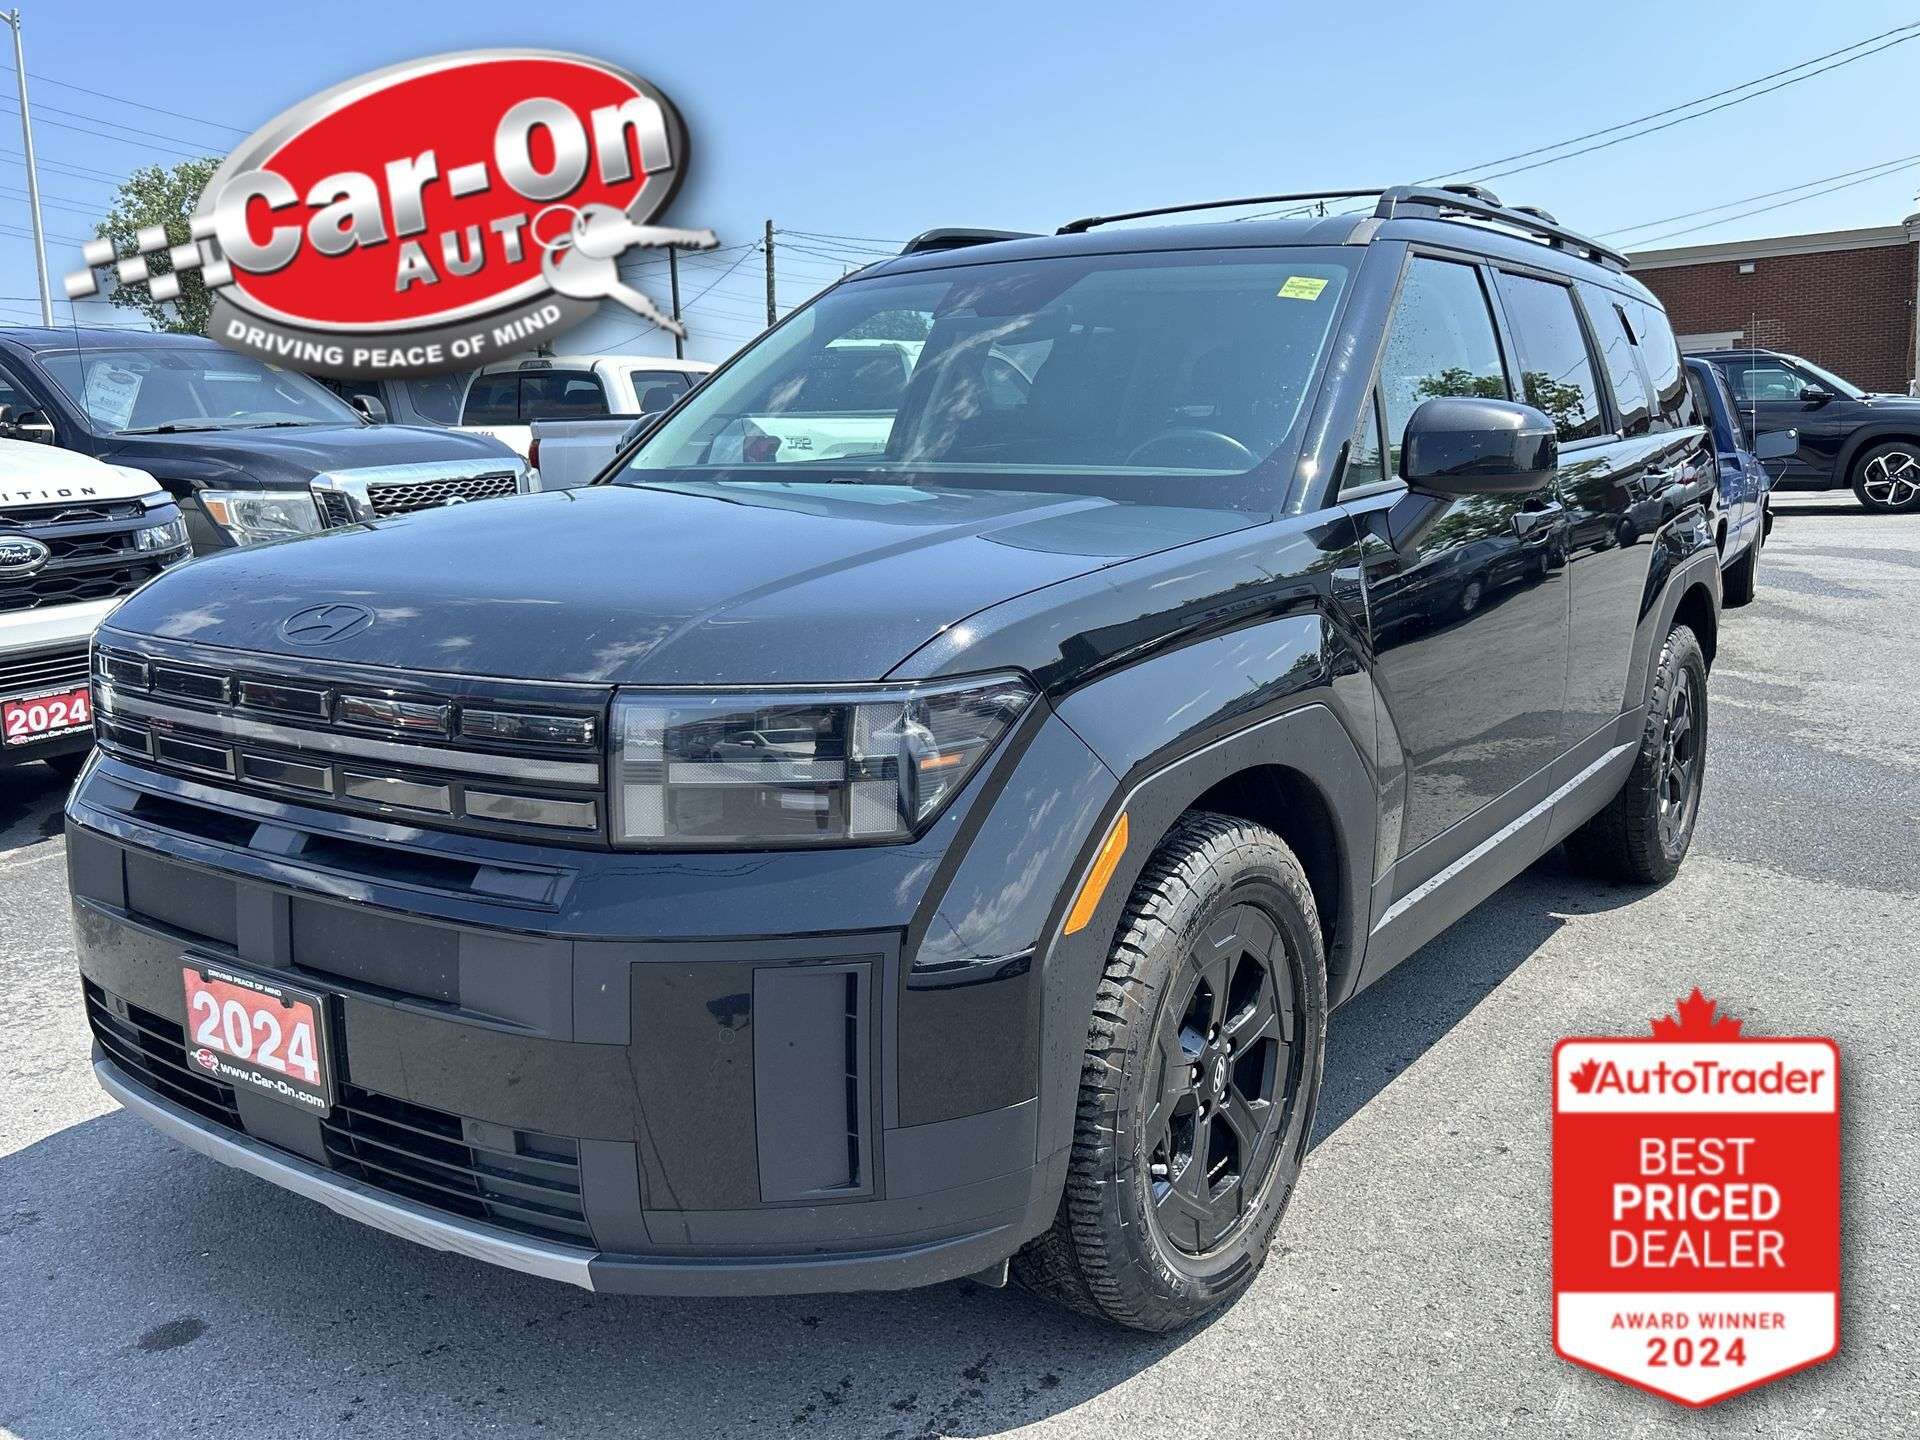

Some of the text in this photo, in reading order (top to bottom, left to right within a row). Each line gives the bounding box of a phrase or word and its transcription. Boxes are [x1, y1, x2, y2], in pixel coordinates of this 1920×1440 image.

[2, 487, 96, 502] ITION
[7, 698, 88, 737] 2024
[192, 990, 320, 1083] 2024
[220, 1062, 326, 1109] www.Car-On.com
